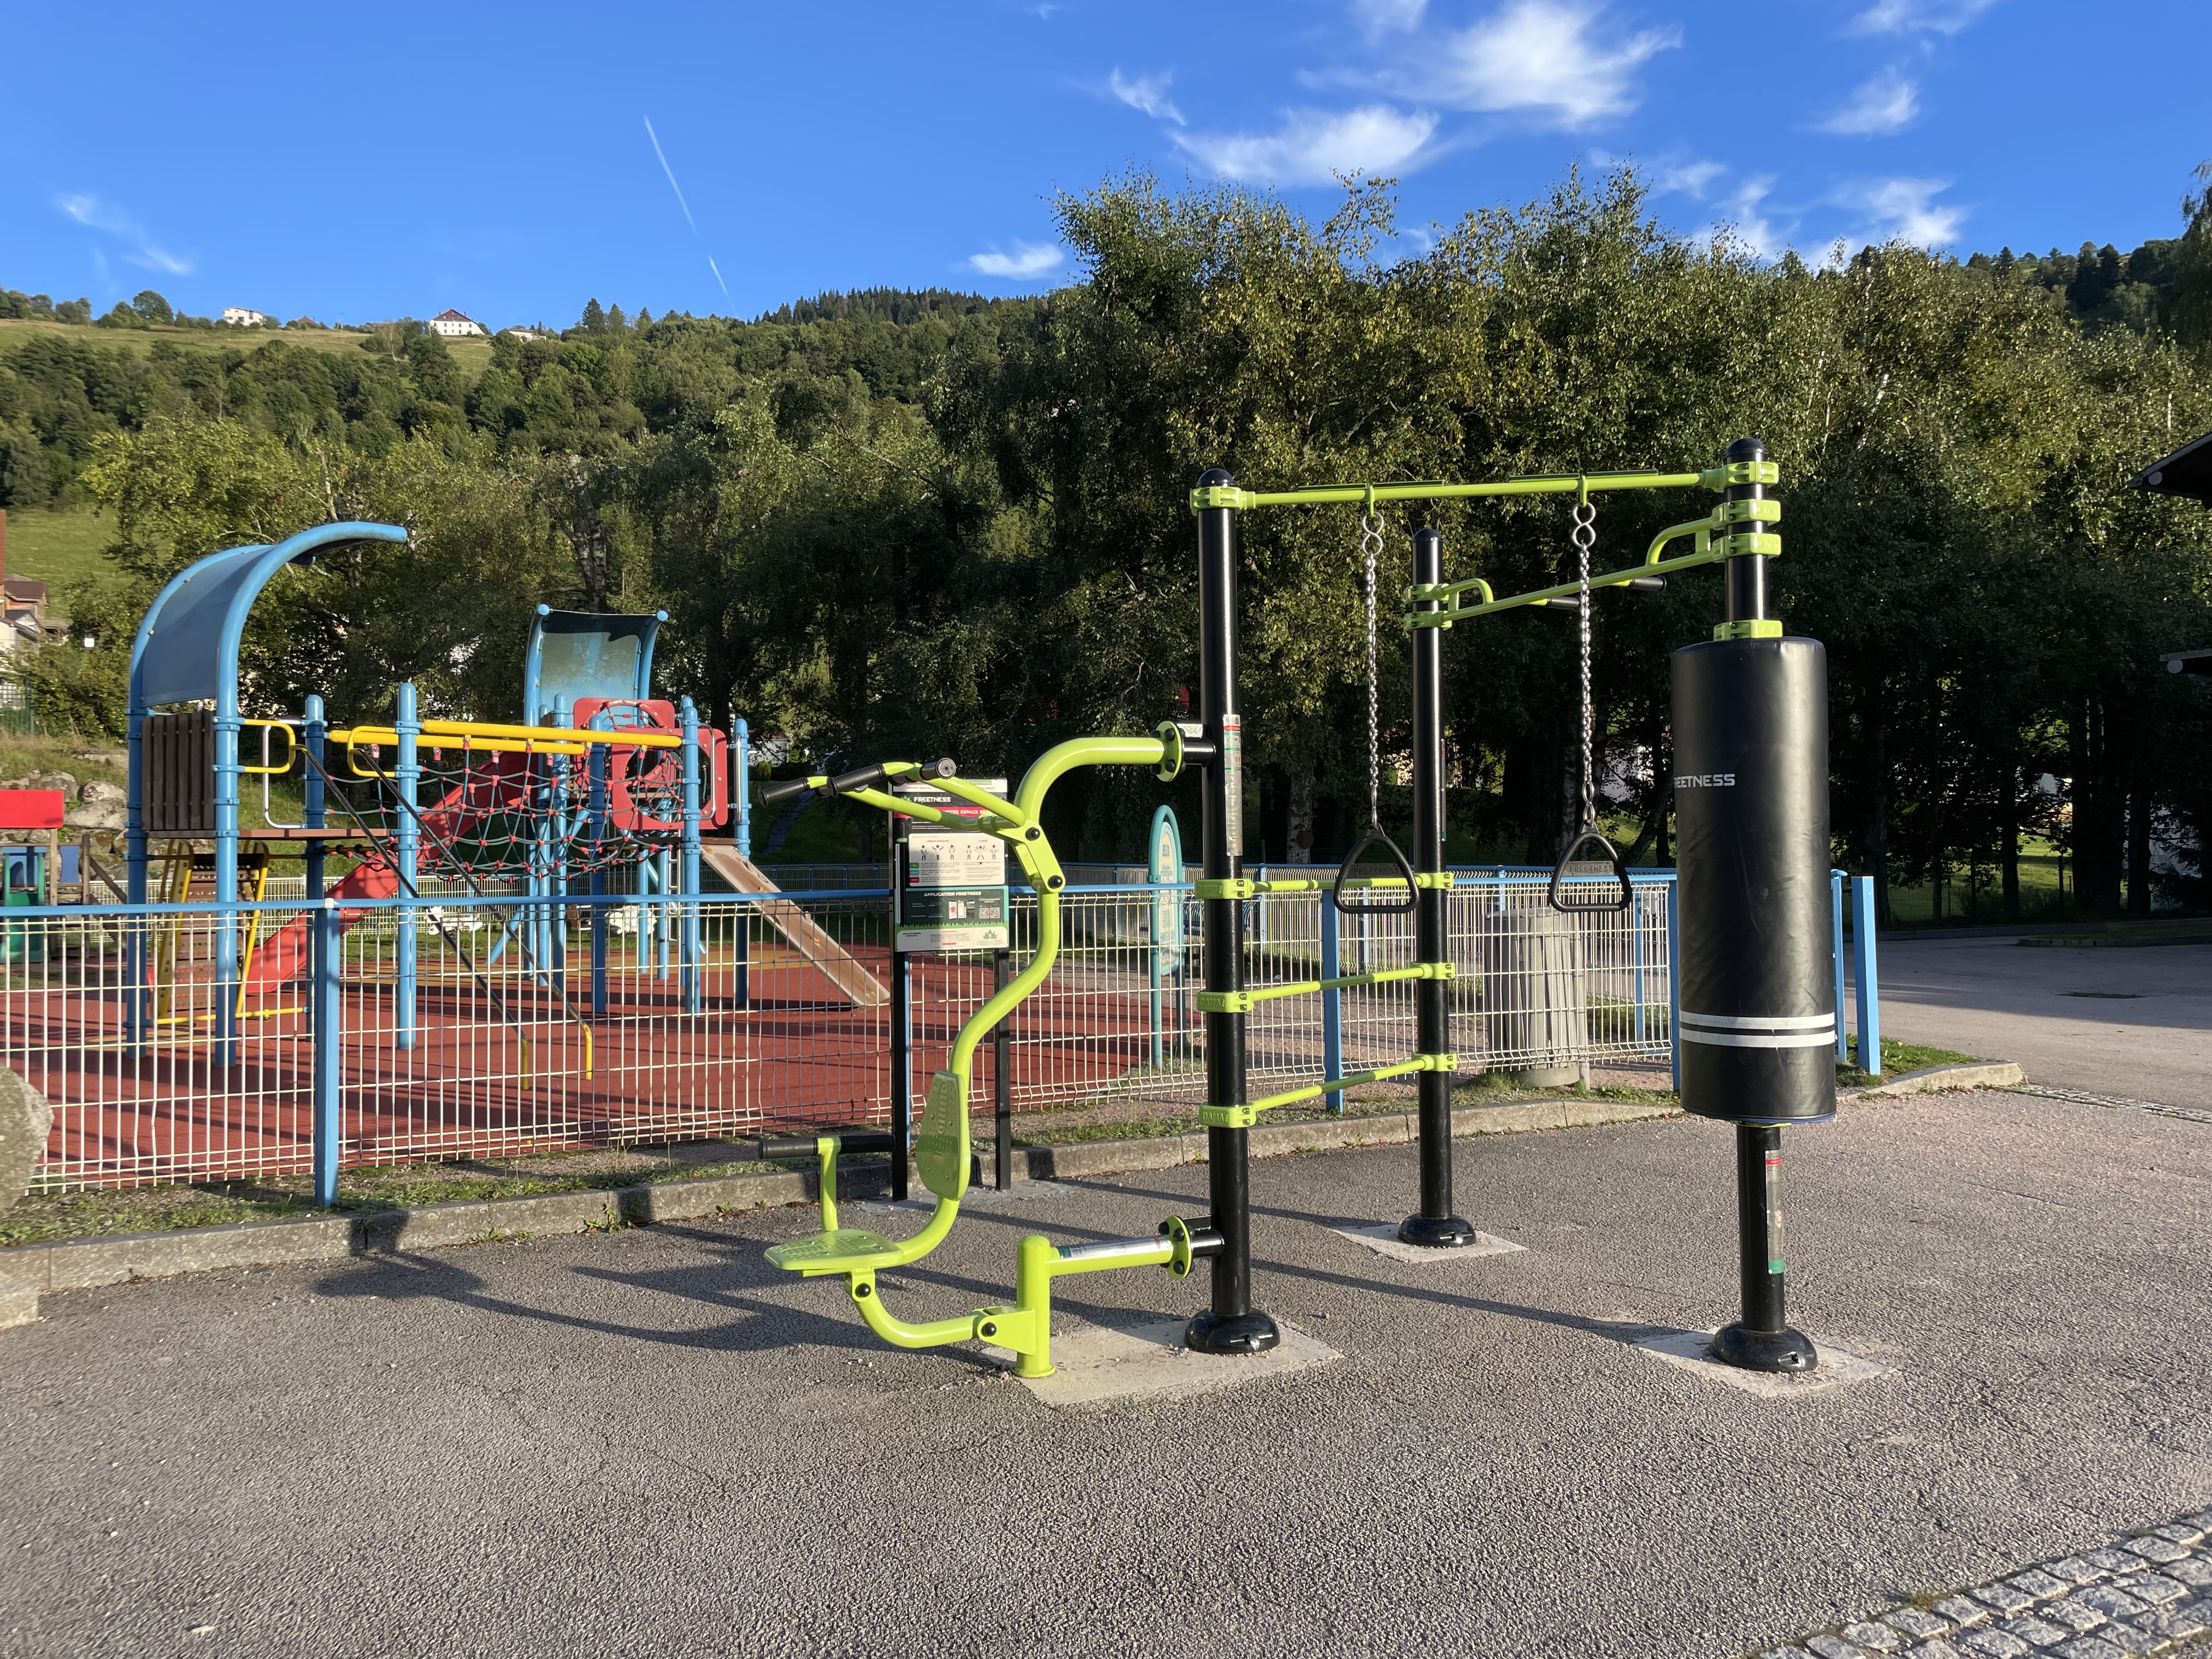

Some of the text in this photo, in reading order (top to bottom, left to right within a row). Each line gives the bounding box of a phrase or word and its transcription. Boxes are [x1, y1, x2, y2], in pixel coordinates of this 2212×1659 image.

[1570, 865, 1613, 873] FREETNESS
[1200, 997, 1221, 1007] DAMA
[1203, 1111, 1224, 1122] DAMA
